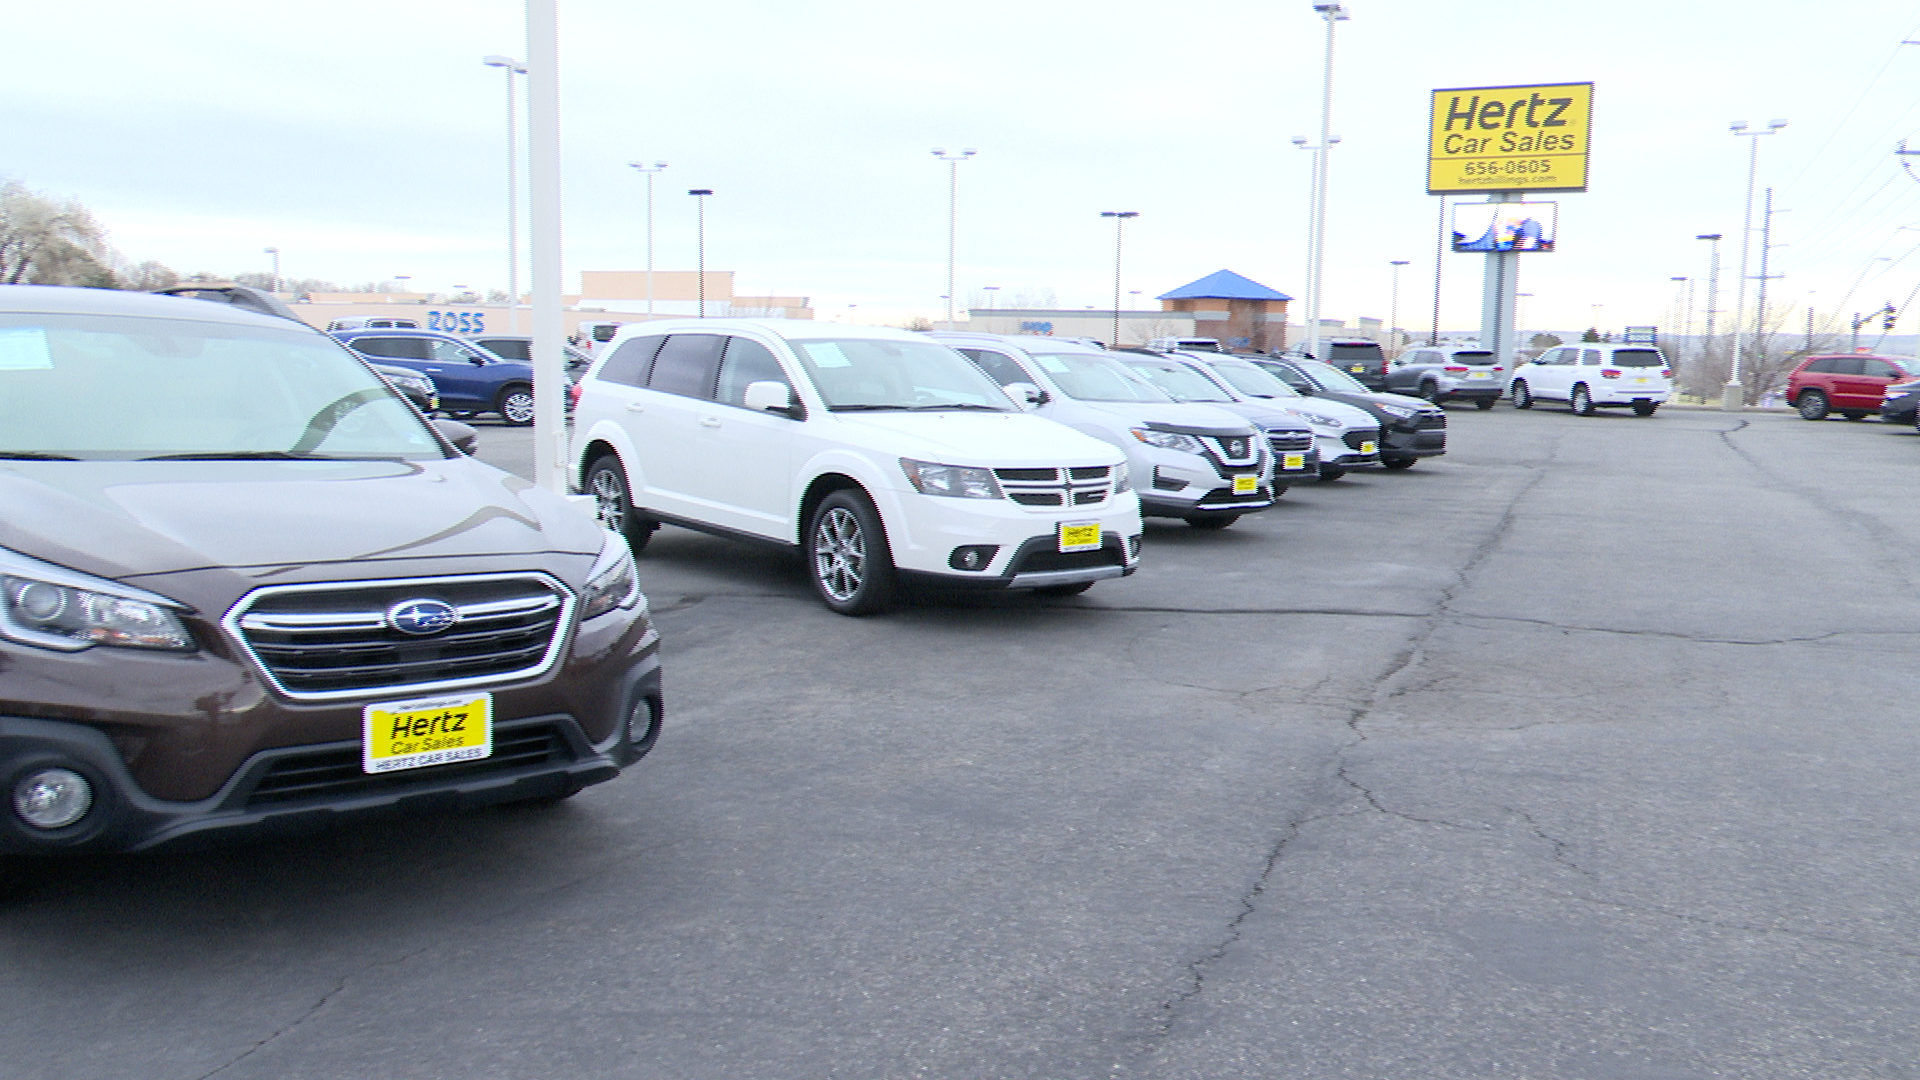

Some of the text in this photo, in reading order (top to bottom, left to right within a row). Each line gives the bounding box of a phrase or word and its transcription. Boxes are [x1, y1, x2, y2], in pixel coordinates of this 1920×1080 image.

[1444, 92, 1574, 131] Hertz
[1444, 130, 1576, 154] Car Sales
[1465, 159, 1551, 175] 656-0605
[1458, 174, 1557, 186] hertzbillings.com
[427, 311, 485, 333] ROSS
[1067, 527, 1094, 538] Hertz
[390, 711, 469, 740] Hertz
[391, 736, 464, 756] Car Sales
[375, 748, 482, 771] HERTZ CAR SALES
